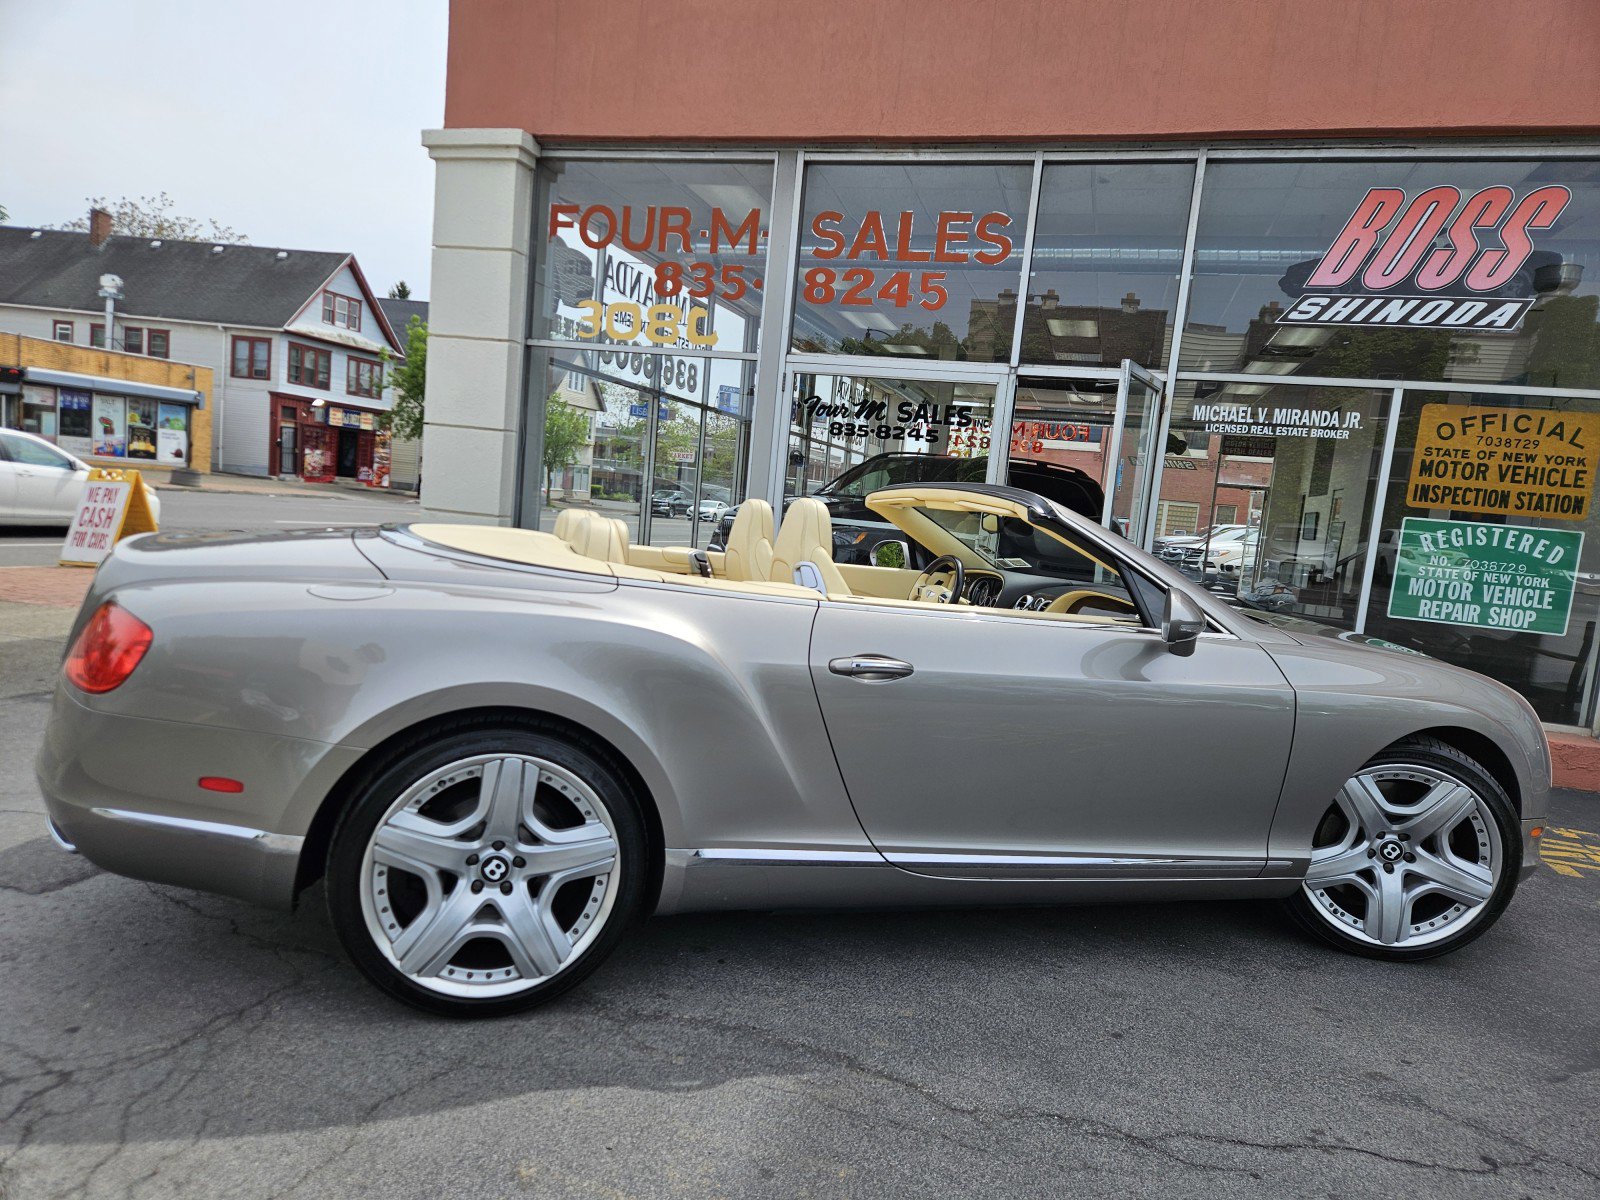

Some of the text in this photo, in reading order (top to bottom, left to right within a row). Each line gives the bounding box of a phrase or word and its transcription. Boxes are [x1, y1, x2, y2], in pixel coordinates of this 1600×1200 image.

[811, 210, 1013, 265] SALES
[1303, 185, 1572, 292] BOSS
[803, 267, 949, 311] 8245
[1288, 297, 1523, 327] SHINODA
[898, 401, 973, 427] SALES
[1192, 405, 1364, 429] MICHAEL V. MIRANDA JR.
[1205, 423, 1249, 434] LICENSED
[1250, 425, 1274, 436] REAL
[1276, 427, 1308, 438] ESTATE
[1310, 428, 1350, 439] BROKER
[1436, 413, 1585, 449] OFFICIAL
[1476, 436, 1540, 450] 7038729
[1424, 447, 1587, 467] STATE OF NEW YORK
[1418, 459, 1588, 489] MOTOR VEHICLE
[1412, 484, 1586, 515] INSPECTION STATION
[79, 506, 116, 529] CASH
[1419, 526, 1565, 565] REGISTERED
[1418, 566, 1550, 589] STATE OF NEW YORK
[1462, 558, 1527, 574] 7038729
[1408, 577, 1556, 610] MOTOR VEHICLE
[1418, 599, 1537, 630] REPAIR SHOP
